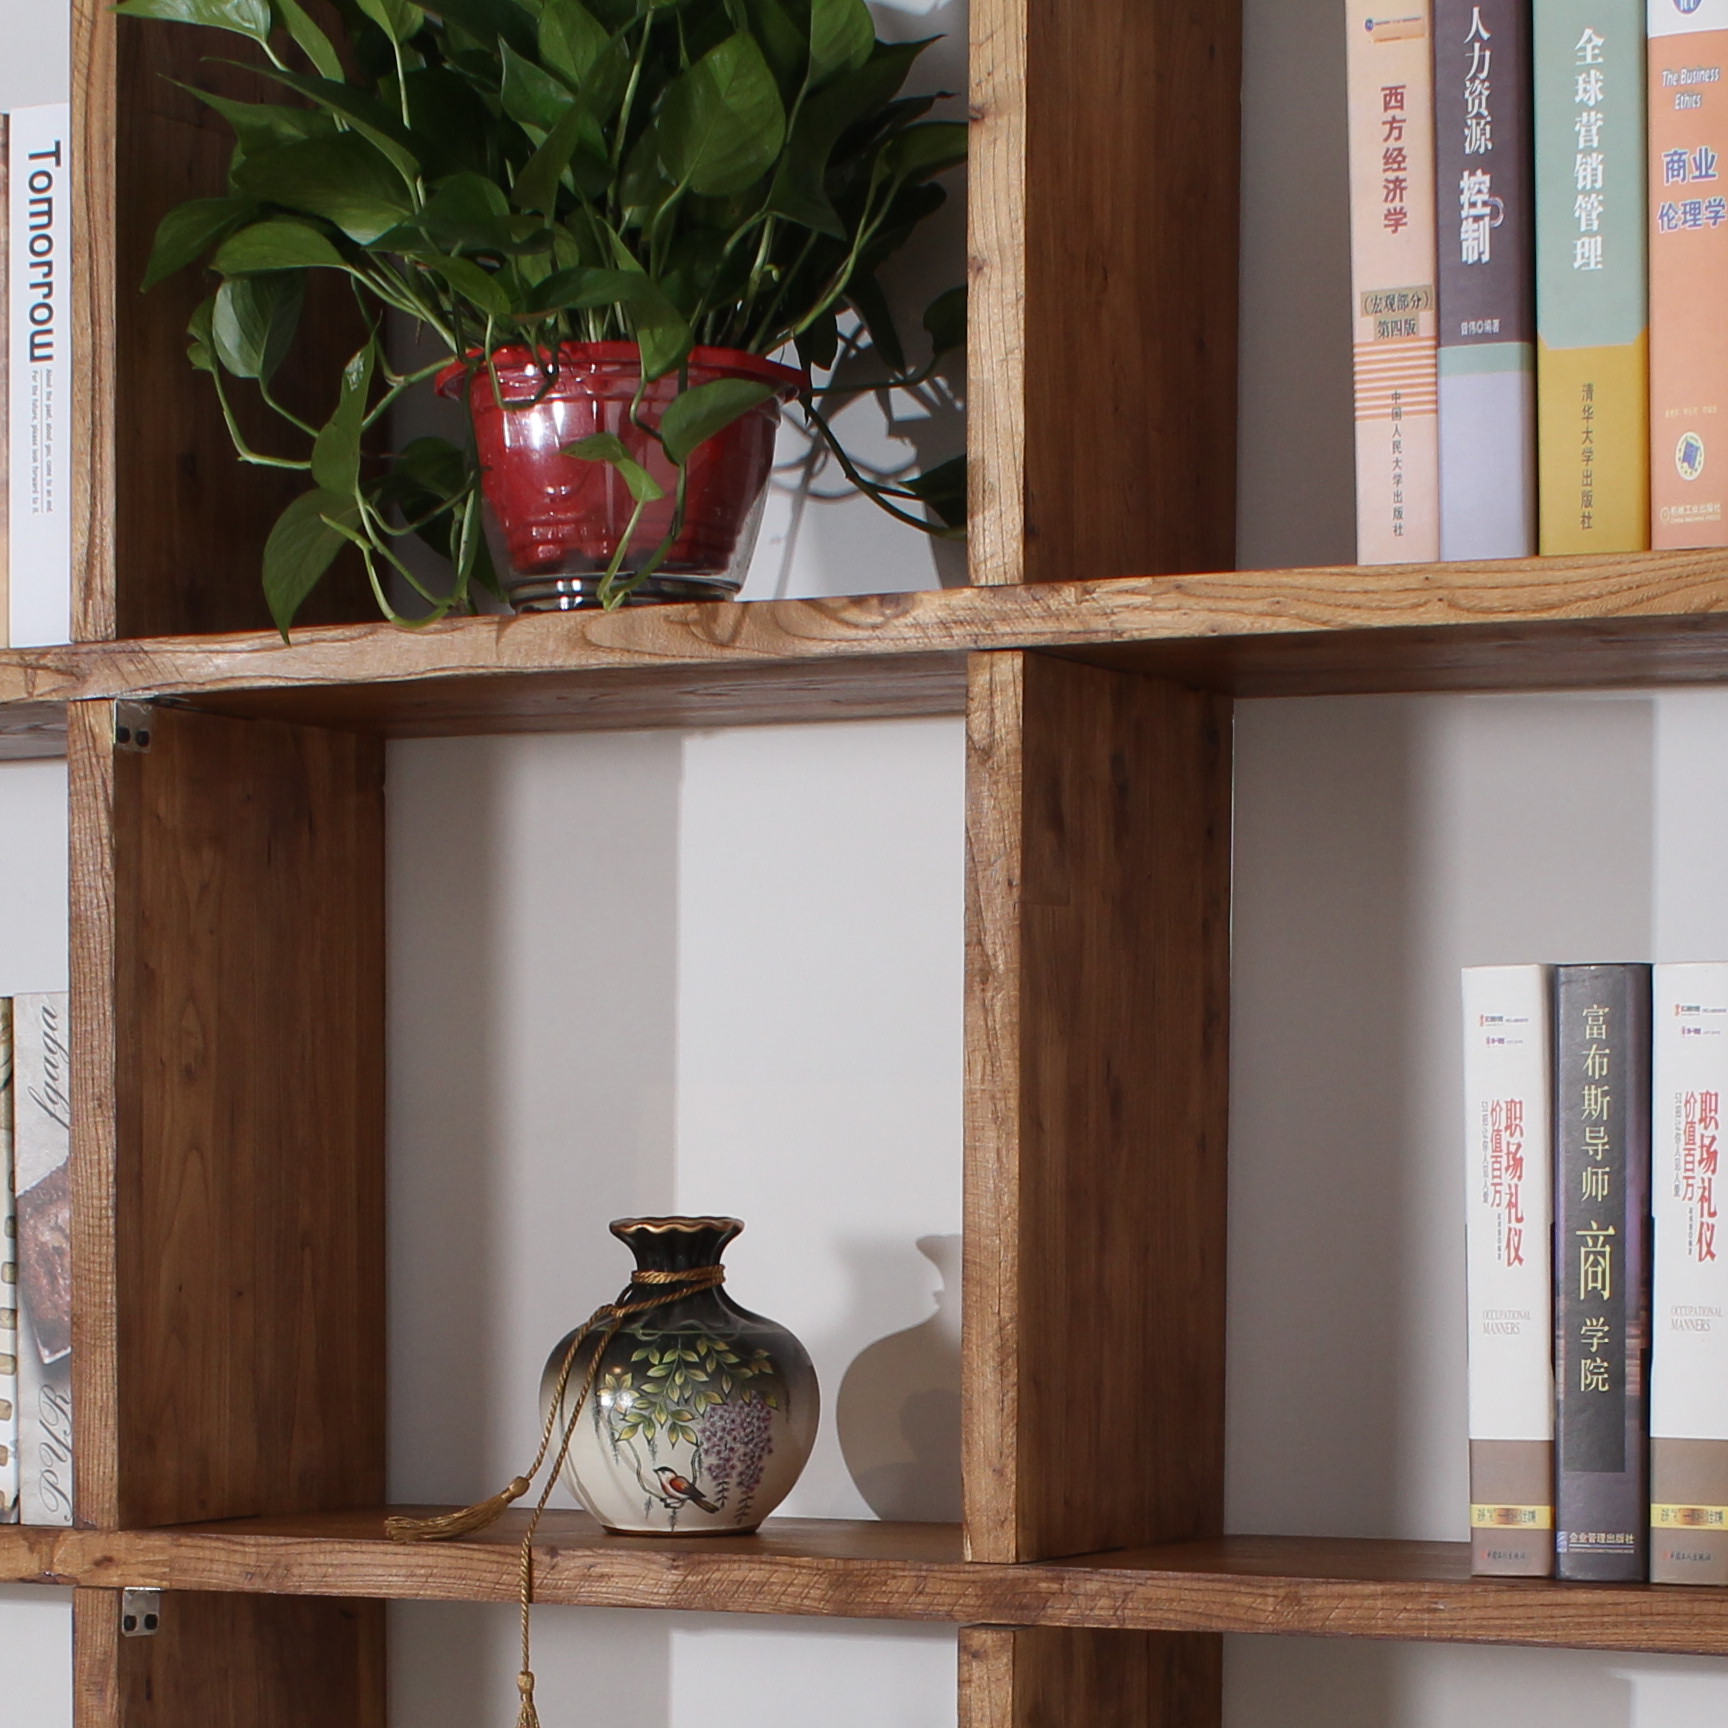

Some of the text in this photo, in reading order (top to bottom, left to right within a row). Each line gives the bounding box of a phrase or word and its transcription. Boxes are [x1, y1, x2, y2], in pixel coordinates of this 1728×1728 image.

[1660, 67, 1720, 87] The Business
[1674, 93, 1702, 110] Ethics
[1379, 86, 1410, 233] 西方经济学
[1573, 27, 1605, 271] 全球营销管理
[1662, 148, 1718, 185] 商业
[1657, 197, 1728, 233] 伦理学
[27, 139, 61, 365] Tomorrow
[1362, 293, 1431, 316] (宏观部分)
[1377, 320, 1417, 339] 第四版
[1391, 390, 1404, 537] 中国人民大学出版社
[1580, 383, 1594, 530] 清华大学出版社
[1489, 1100, 1504, 1208] 价值百万
[1504, 1098, 1524, 1267] 职场礼仪
[1682, 1091, 1696, 1203] 价值百万
[1696, 1090, 1717, 1262] 职场礼仪
[1483, 1321, 1520, 1335] MANNERS
[1670, 1319, 1711, 1333] MANNERS
[1569, 1532, 1634, 1545] 企业管理出版社
